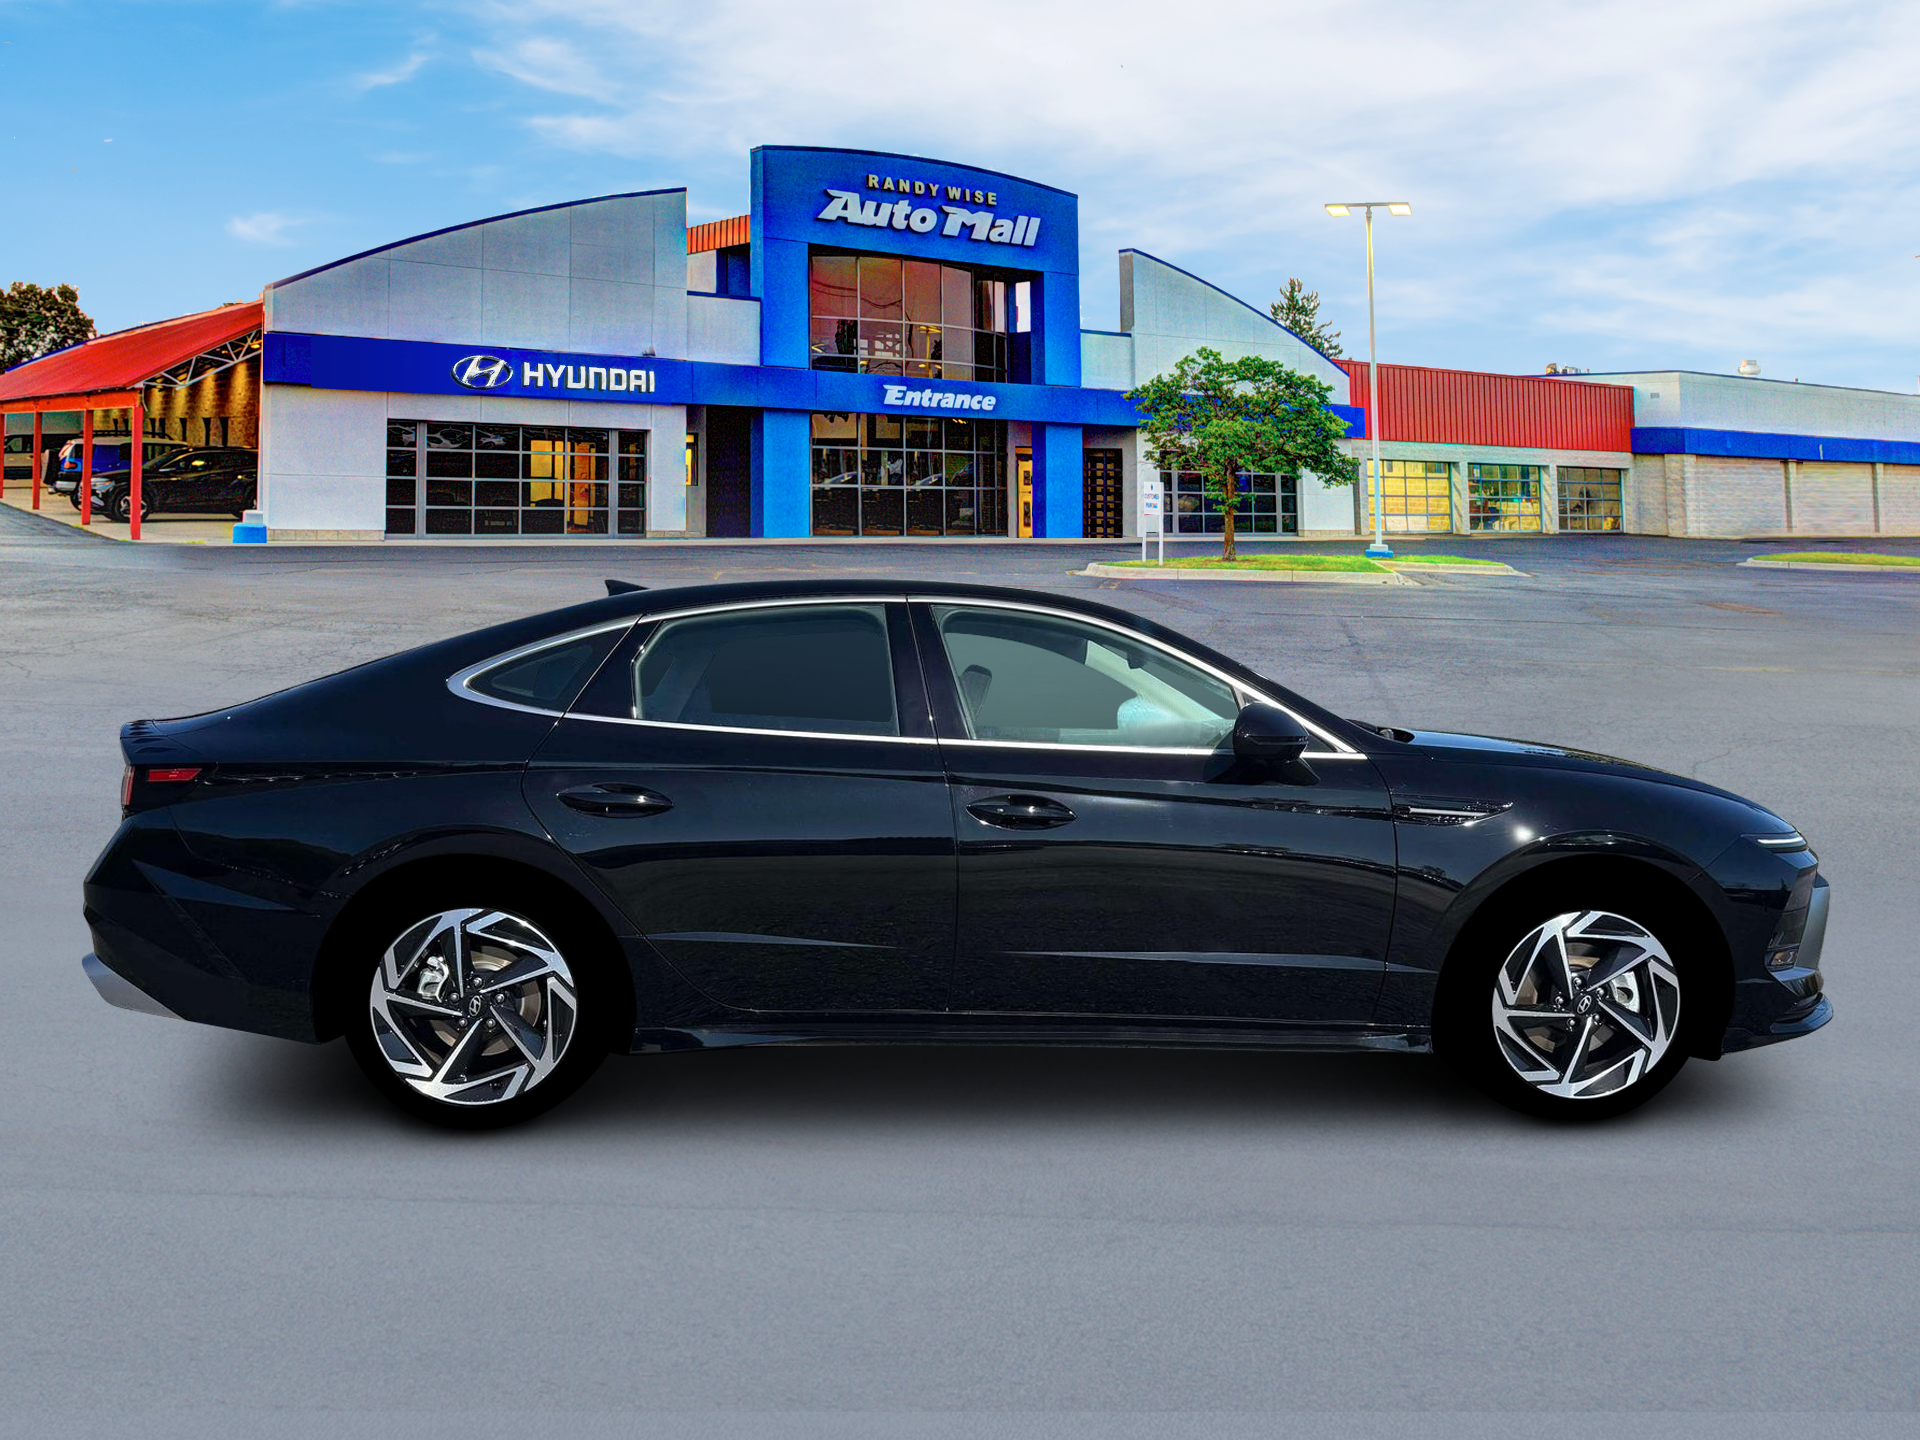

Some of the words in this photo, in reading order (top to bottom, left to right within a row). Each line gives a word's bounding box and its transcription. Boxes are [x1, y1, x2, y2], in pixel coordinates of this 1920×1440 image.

[866, 174, 939, 197] RANDY
[945, 185, 998, 206] WISE
[815, 188, 938, 234] Auto
[941, 205, 1041, 247] Mall
[521, 361, 656, 393] HYUNDAI
[883, 384, 997, 411] Entrance
